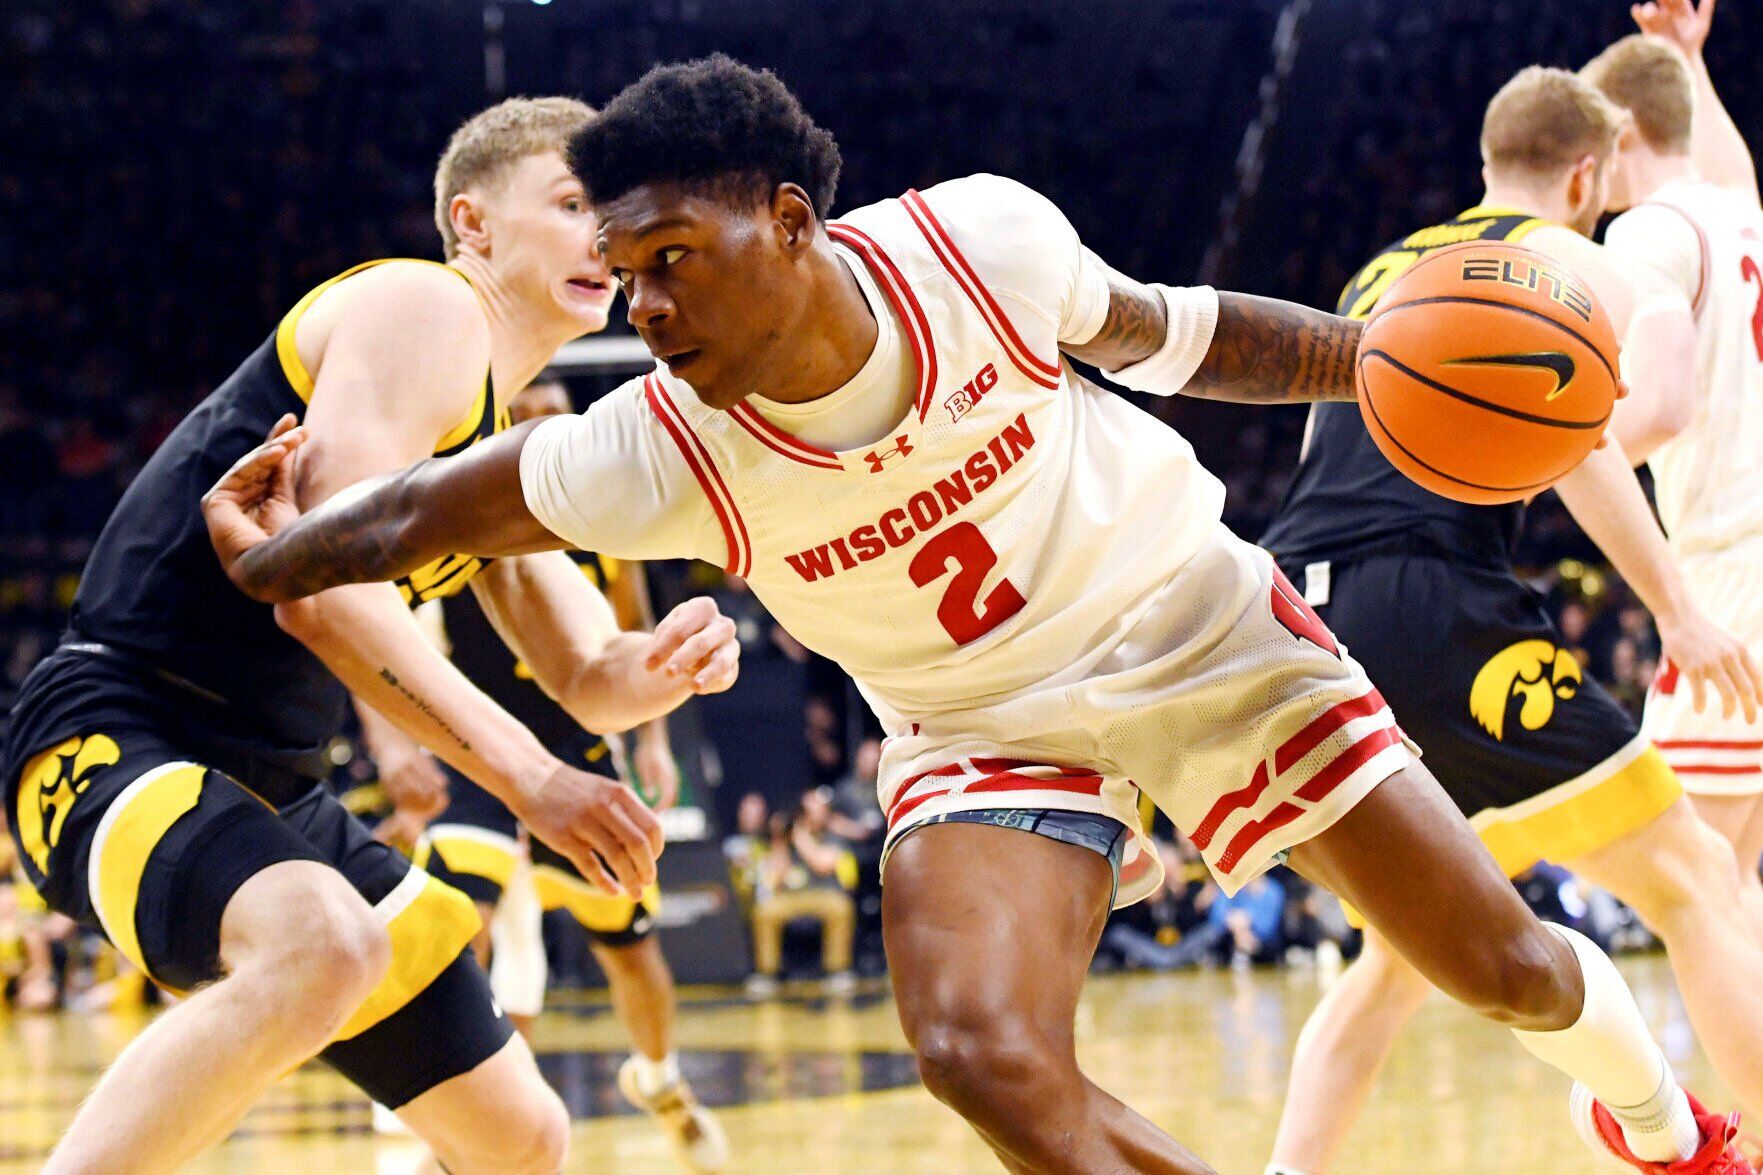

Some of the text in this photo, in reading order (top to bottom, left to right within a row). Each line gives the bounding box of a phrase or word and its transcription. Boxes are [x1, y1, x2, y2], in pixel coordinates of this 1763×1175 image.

[1462, 258, 1592, 322] ELITE
[784, 413, 1035, 582] WISCONSIN
[908, 521, 1027, 646] 2
